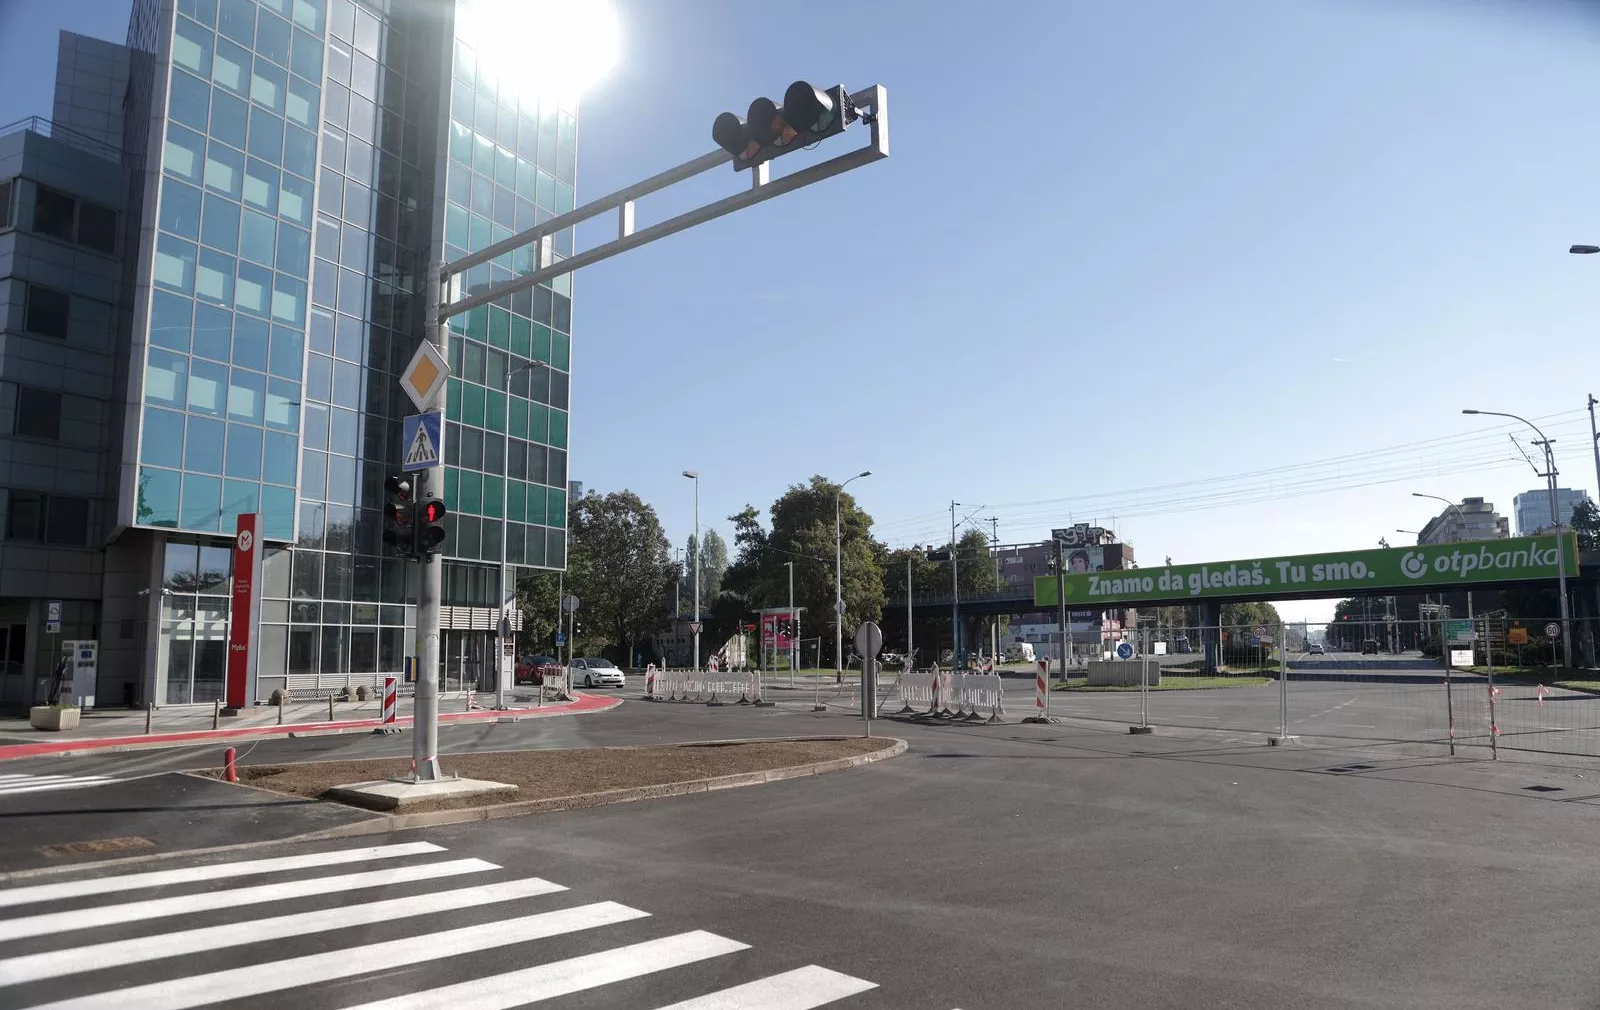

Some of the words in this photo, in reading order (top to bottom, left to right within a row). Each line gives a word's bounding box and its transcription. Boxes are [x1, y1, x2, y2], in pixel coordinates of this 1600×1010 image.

[1434, 542, 1559, 578] otpbanka
[1088, 576, 1153, 596] Znamo
[1159, 570, 1184, 592] da
[1188, 562, 1271, 596] gledaš.
[1276, 561, 1306, 584] Tu
[1312, 561, 1375, 581] smo.
[1547, 626, 1557, 634] 60
